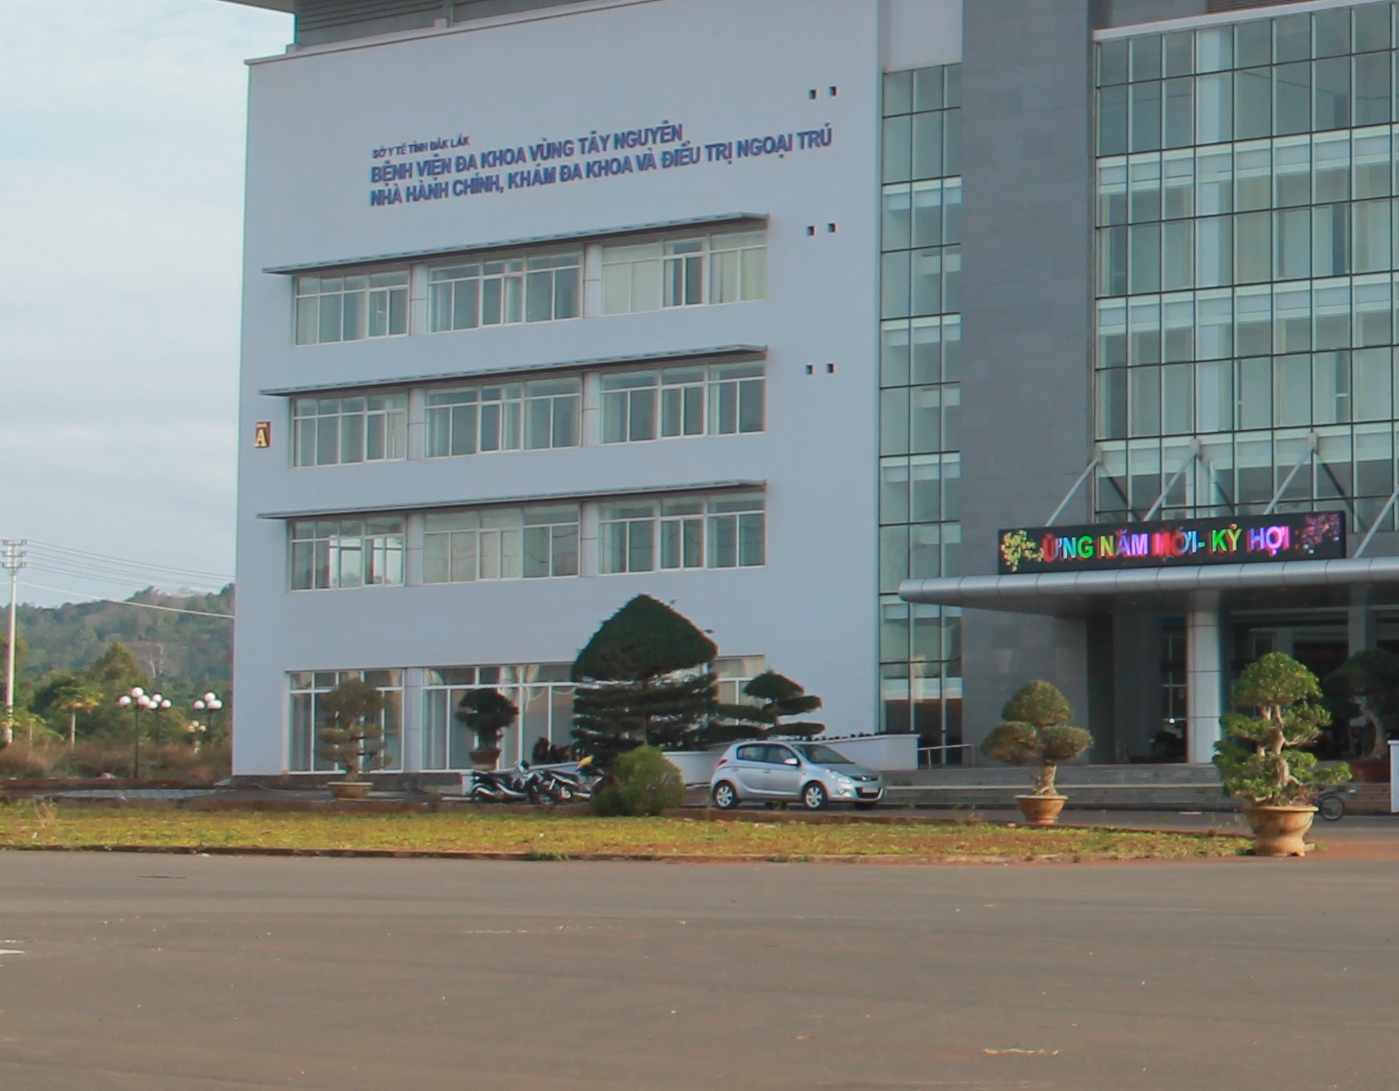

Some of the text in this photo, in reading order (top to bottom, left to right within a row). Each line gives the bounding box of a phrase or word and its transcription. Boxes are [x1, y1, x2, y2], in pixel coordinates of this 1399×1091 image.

[370, 119, 683, 188] BỆNH VIỆN ĐA KHOA VÙNG TÂY NGUYÊN
[370, 184, 402, 207] NHÀ
[405, 177, 449, 203] HÀNH
[507, 163, 556, 190] KHÁM
[559, 164, 583, 182] ĐA
[586, 156, 633, 179] KHOA
[636, 147, 656, 172] VÀ
[705, 142, 732, 165] TRỊ
[737, 133, 793, 158] NGOẠI
[796, 122, 832, 150] TRÚ
[386, 147, 394, 156] Y
[254, 428, 269, 448] A
[1097, 528, 1149, 559] NĂM
[1209, 523, 1243, 553] KỶ
[1246, 525, 1290, 557] HỢI
